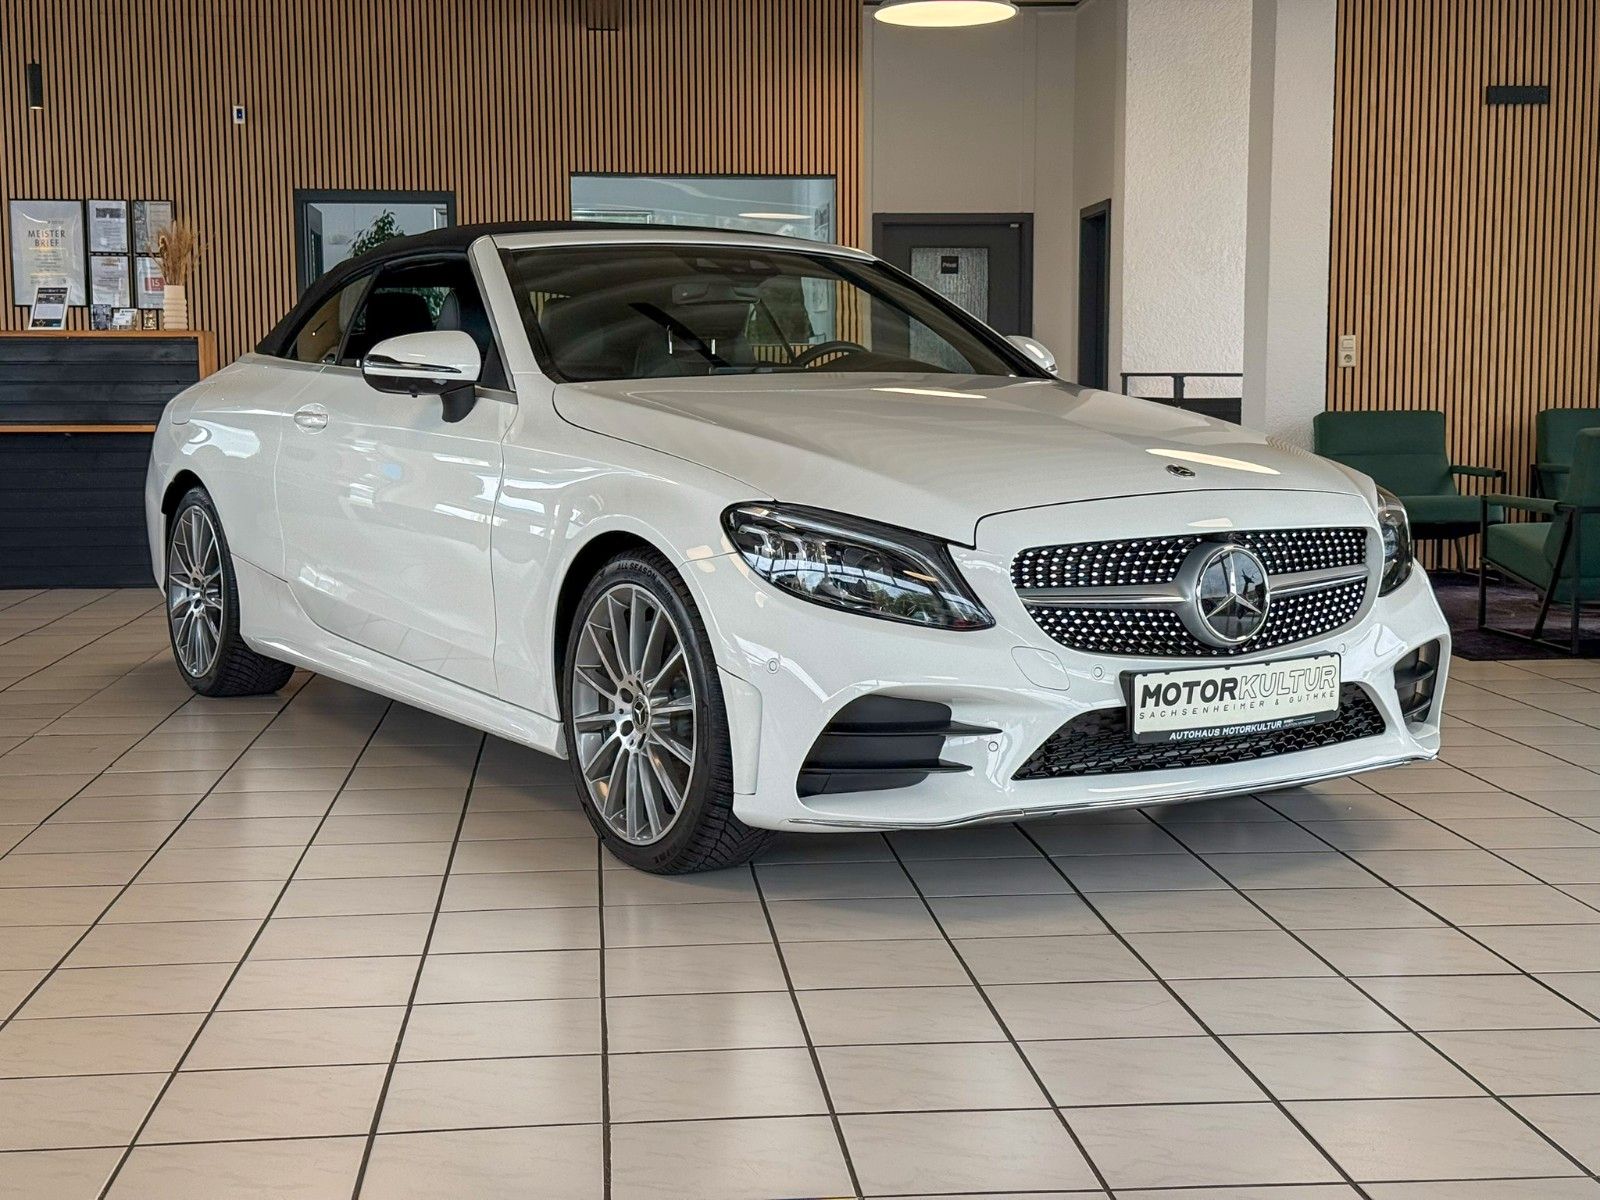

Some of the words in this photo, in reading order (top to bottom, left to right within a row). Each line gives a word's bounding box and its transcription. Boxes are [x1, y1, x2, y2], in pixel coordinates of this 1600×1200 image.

[28, 229, 66, 239] MEISTER
[35, 238, 60, 247] BRIEF
[629, 562, 658, 581] SEASON
[1140, 664, 1337, 709] MOTORKULTUR
[1139, 701, 1265, 720] SACHSENHEIMER
[1274, 698, 1280, 707] &
[1288, 690, 1335, 704] GUTHKE
[1169, 727, 1221, 741] AUTOHAUS
[1221, 719, 1283, 737] MOTORKULTUR
